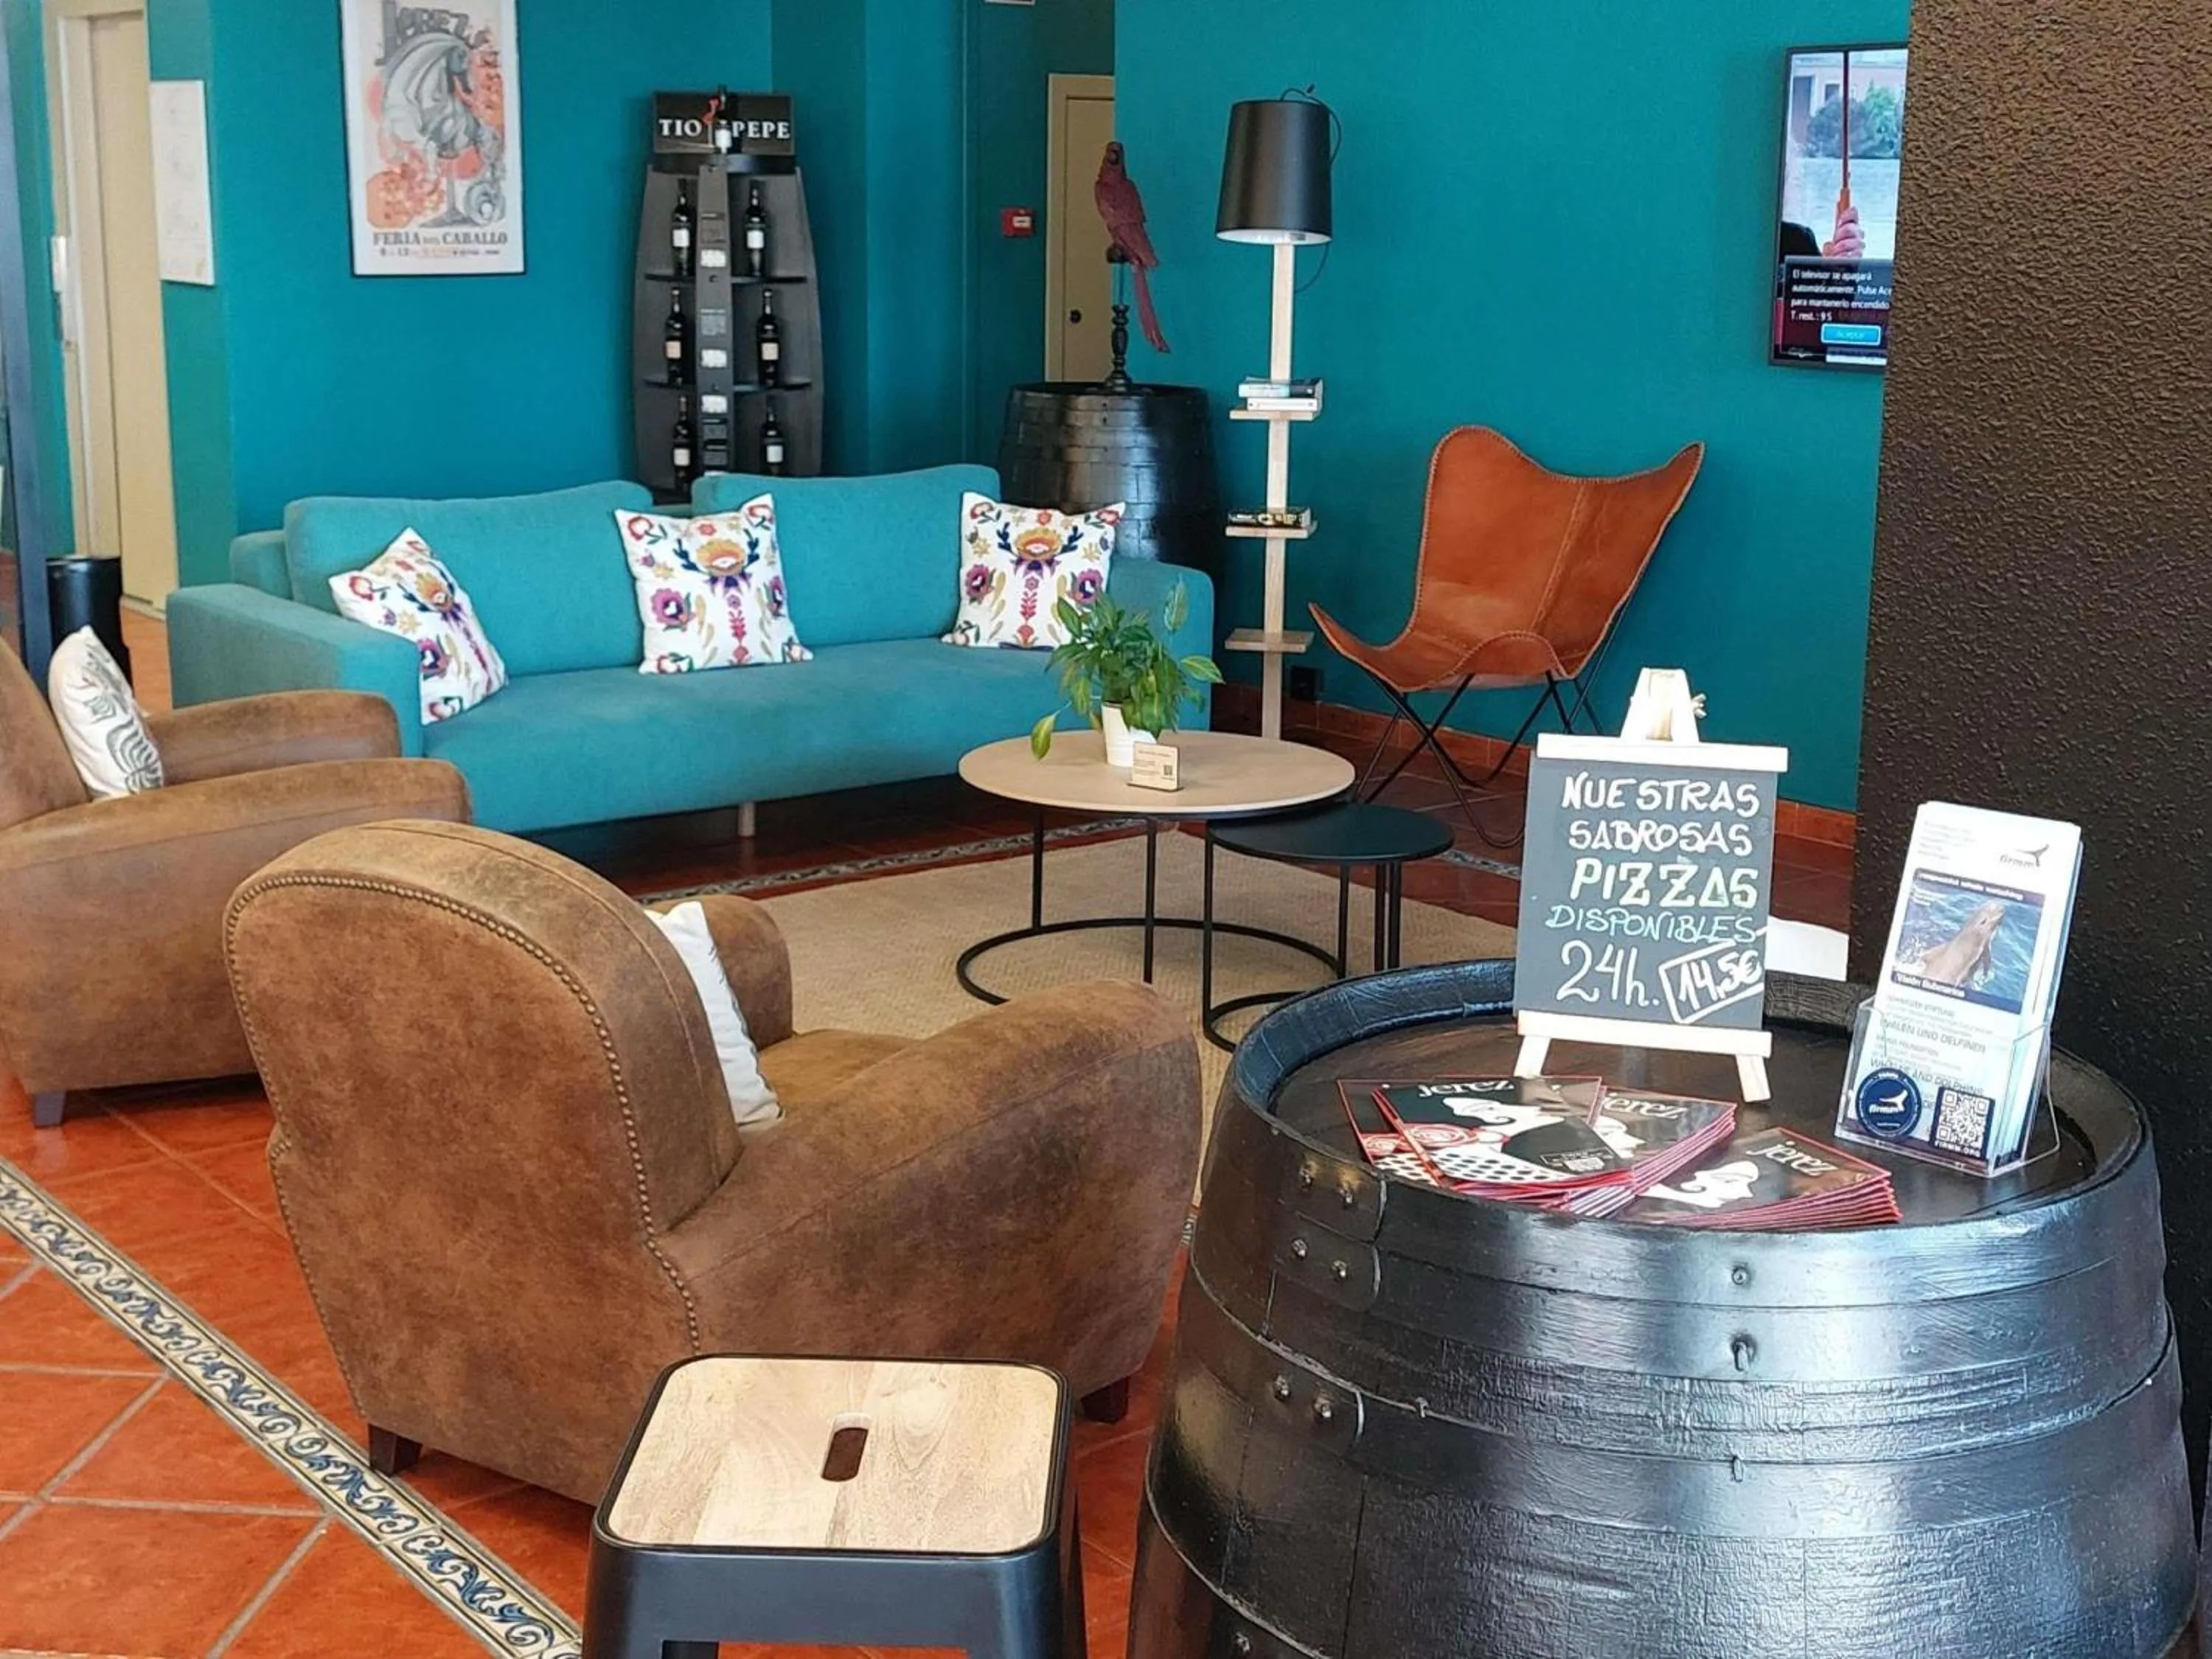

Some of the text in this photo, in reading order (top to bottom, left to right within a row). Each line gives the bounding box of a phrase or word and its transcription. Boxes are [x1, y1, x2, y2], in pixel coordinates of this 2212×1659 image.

[658, 119, 790, 139] TIO PEPE
[373, 232, 420, 245] FERIA
[442, 232, 507, 245] CABALLO
[1792, 270, 1800, 279] El
[1832, 271, 1841, 279] se
[1857, 285, 1877, 295] Pulse
[1790, 299, 1806, 307] para
[1562, 771, 1759, 818] NUESTRAS
[1568, 819, 1753, 857] SABROSAS
[1570, 857, 1759, 908] PIZZAS
[1545, 905, 1756, 943] DISPONIBLES
[1557, 940, 1660, 1006] 24h.
[1917, 1026, 1939, 1041] UND
[1913, 1069, 1933, 1082] AND
[1746, 1141, 1838, 1177] jerez
